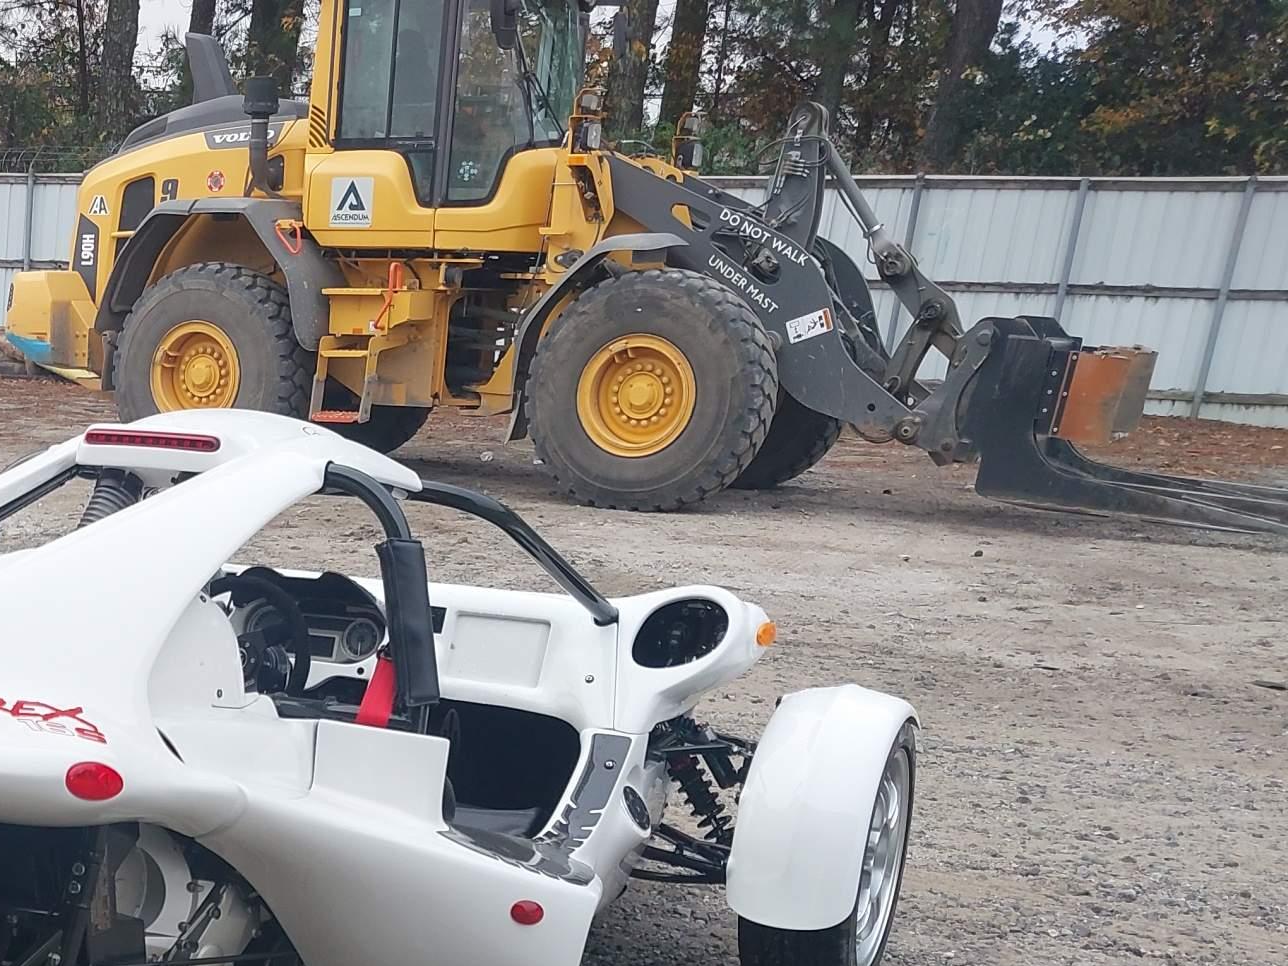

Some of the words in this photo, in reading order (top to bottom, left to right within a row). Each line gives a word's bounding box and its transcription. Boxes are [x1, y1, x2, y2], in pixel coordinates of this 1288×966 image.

[213, 129, 275, 144] VOLO
[332, 213, 369, 221] ASCENDUM
[81, 234, 95, 266] L90H
[719, 208, 740, 226] DO
[740, 221, 771, 243] NOT
[772, 238, 809, 266] WALK
[708, 254, 748, 290] UNDER
[746, 284, 779, 313] MAST
